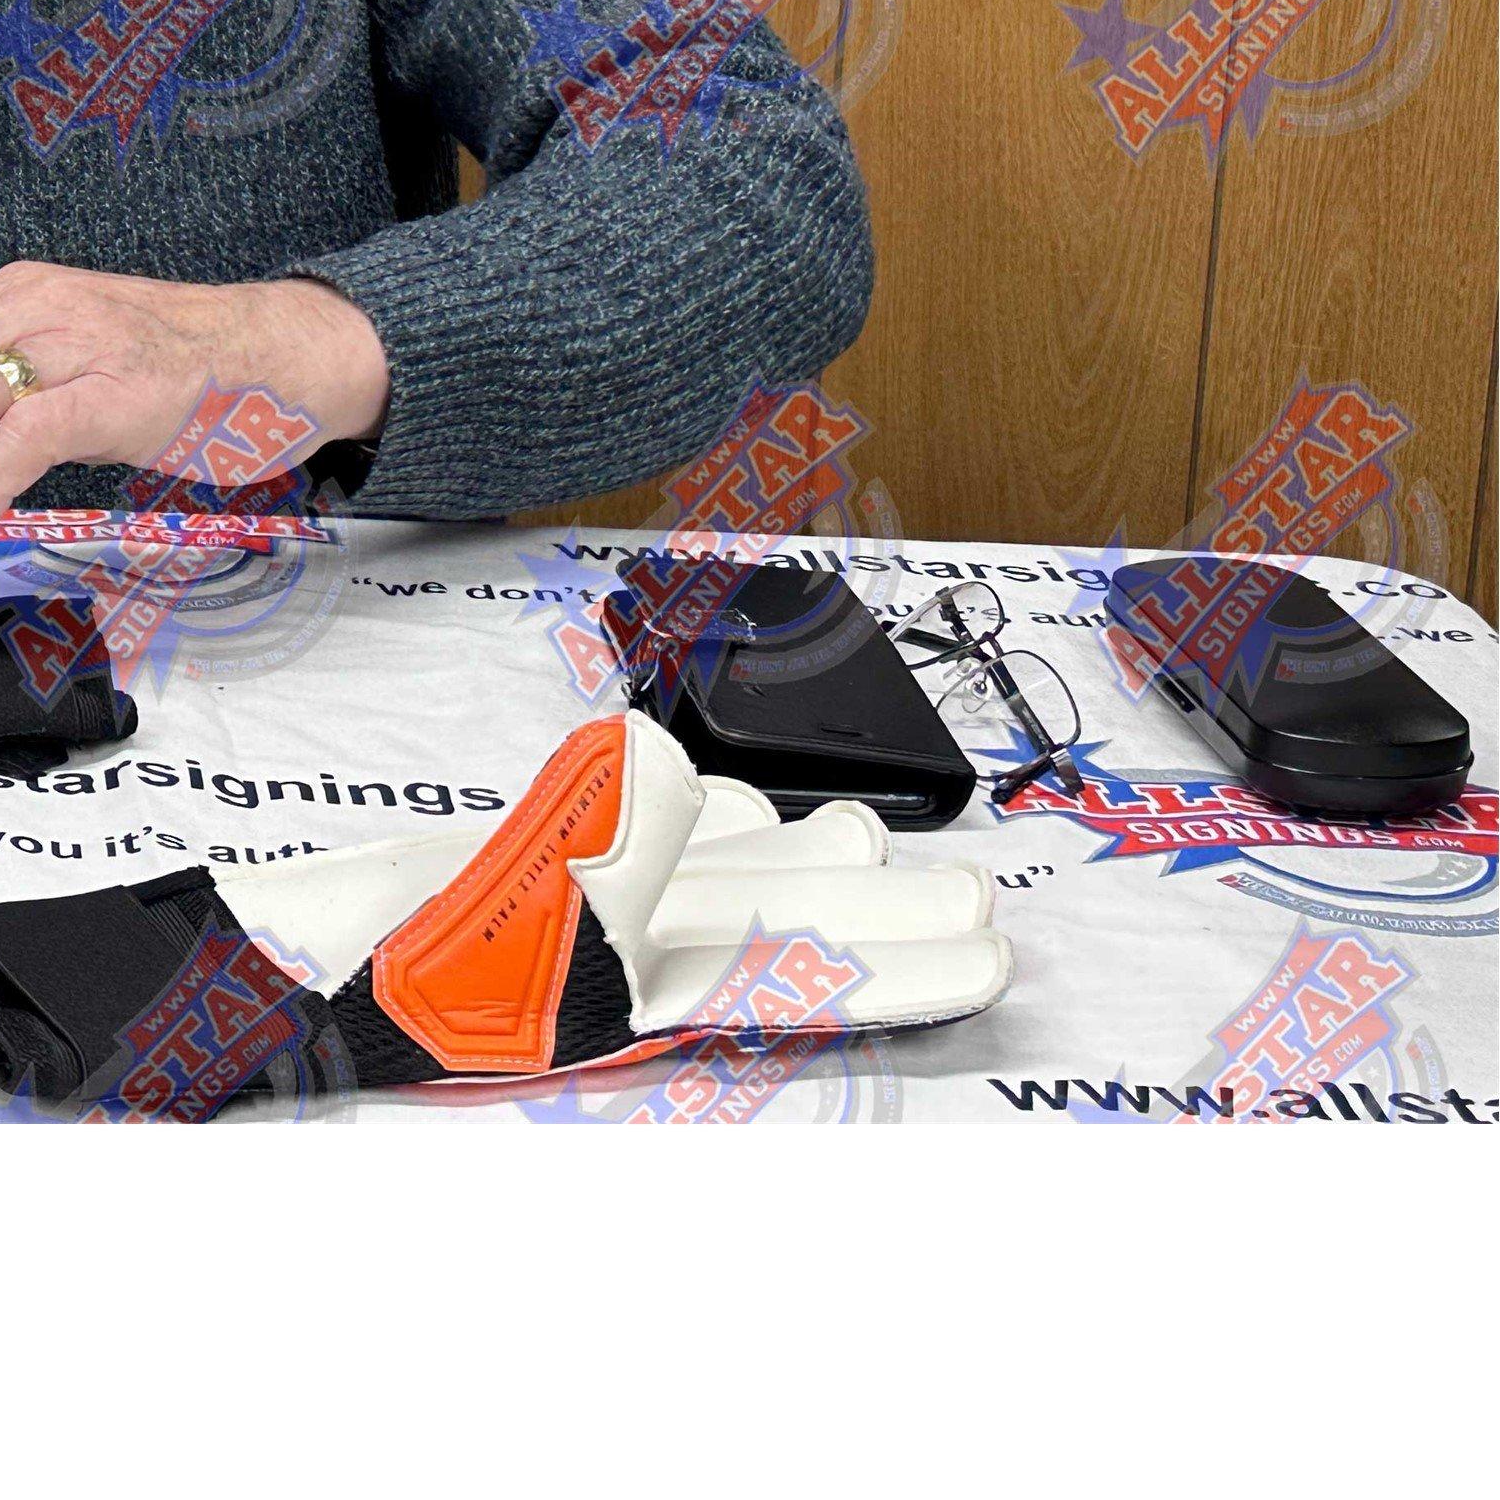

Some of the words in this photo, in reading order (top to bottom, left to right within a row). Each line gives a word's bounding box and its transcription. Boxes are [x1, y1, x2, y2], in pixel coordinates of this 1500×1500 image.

[465, 583, 599, 604] don't
[559, 765, 612, 841] PREMIUM
[104, 826, 187, 857] it's
[1126, 818, 1400, 845] SIGNINGS
